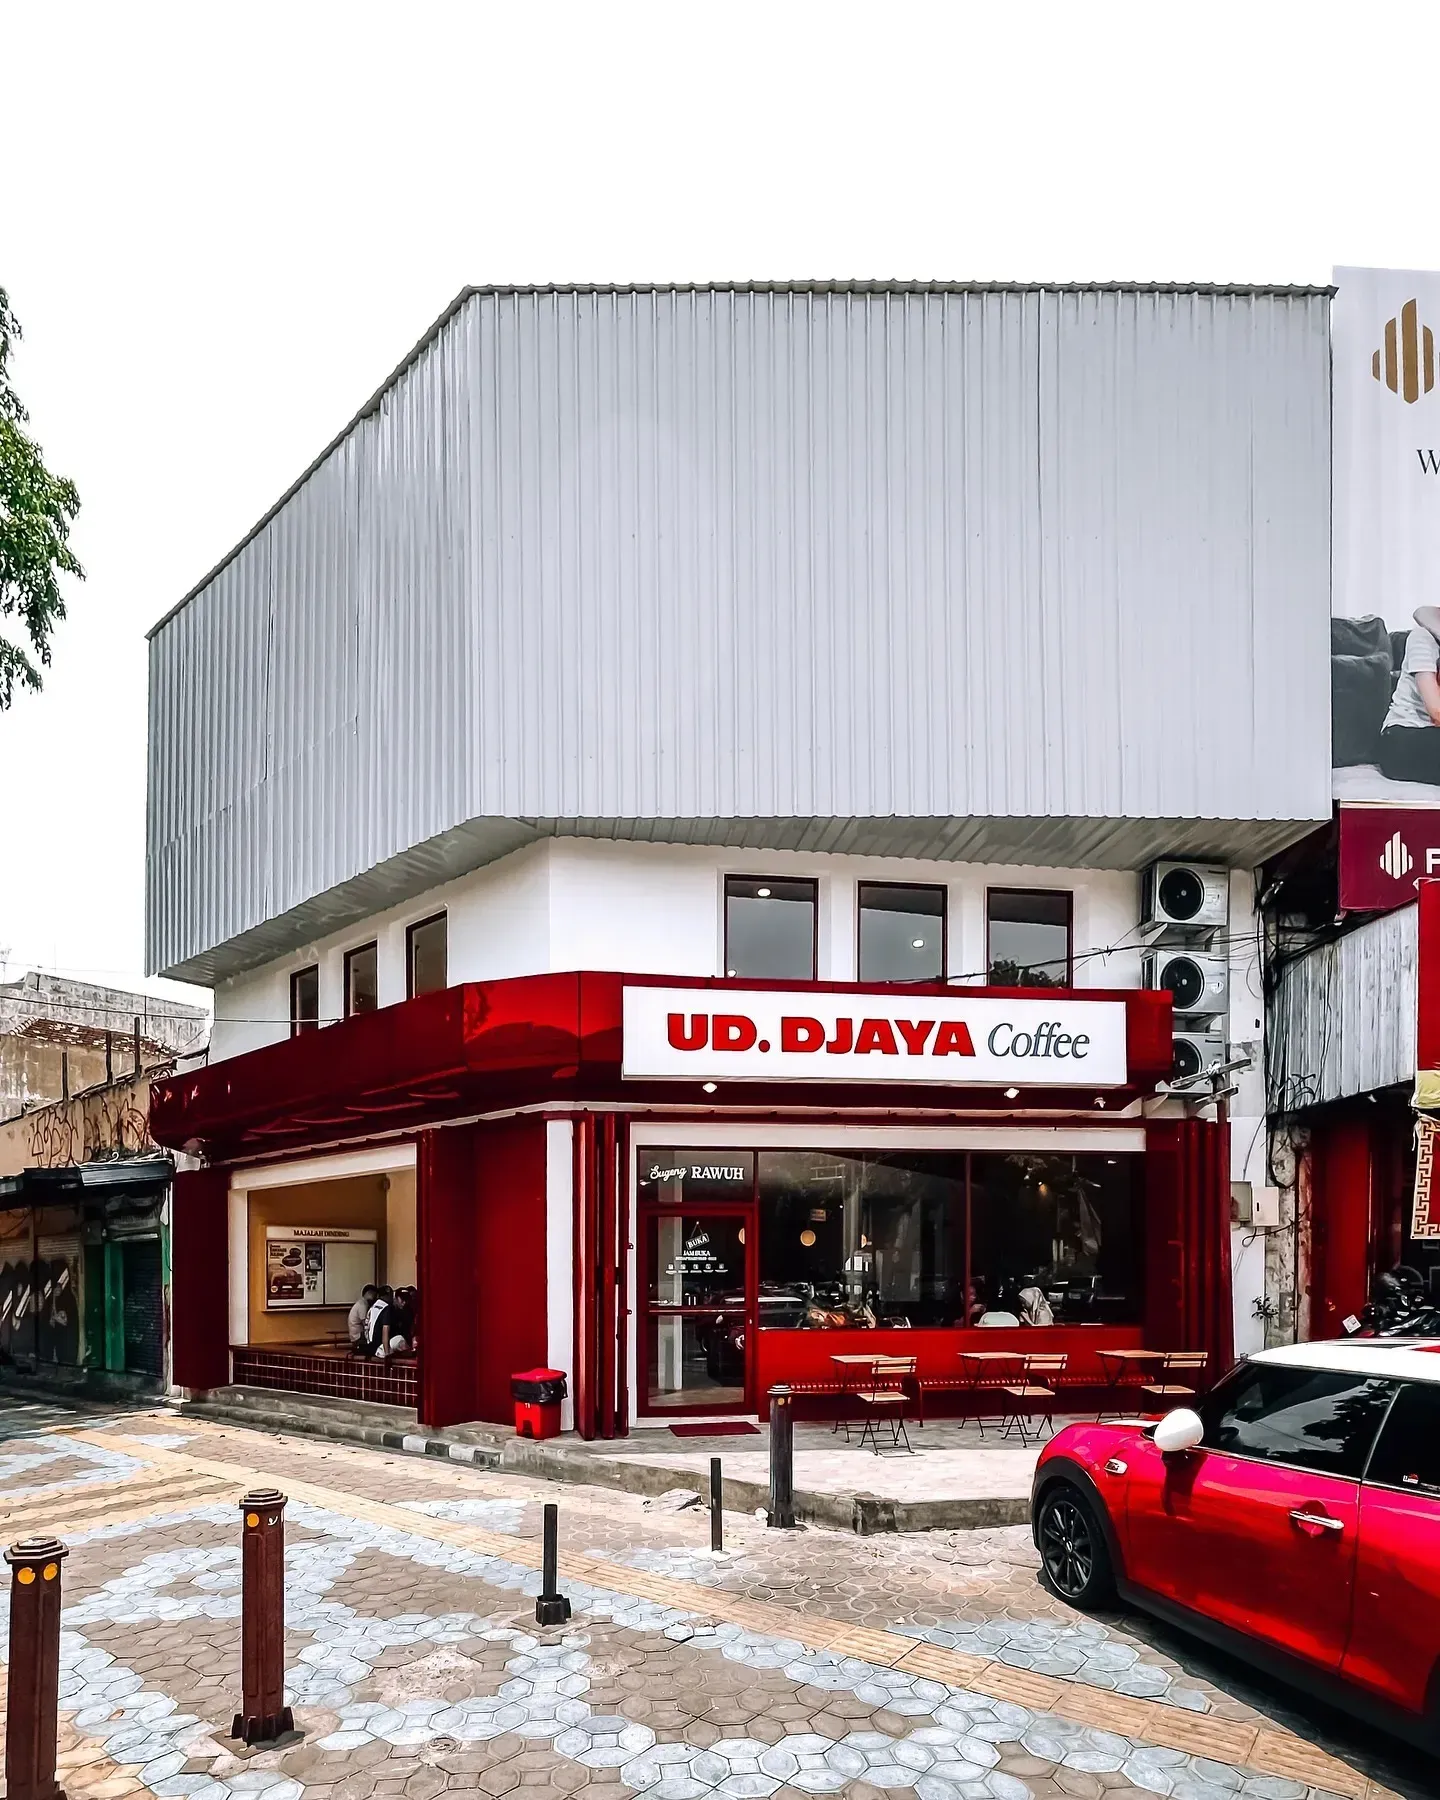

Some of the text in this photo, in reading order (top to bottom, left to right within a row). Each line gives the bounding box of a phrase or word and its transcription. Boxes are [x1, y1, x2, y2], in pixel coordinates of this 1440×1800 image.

[667, 1013, 1090, 1060] UD. DJAYA Coffee
[649, 1164, 744, 1181] Sugeng RAWUH
[293, 1229, 323, 1237] MAJALAH
[687, 1235, 708, 1249] BUKA
